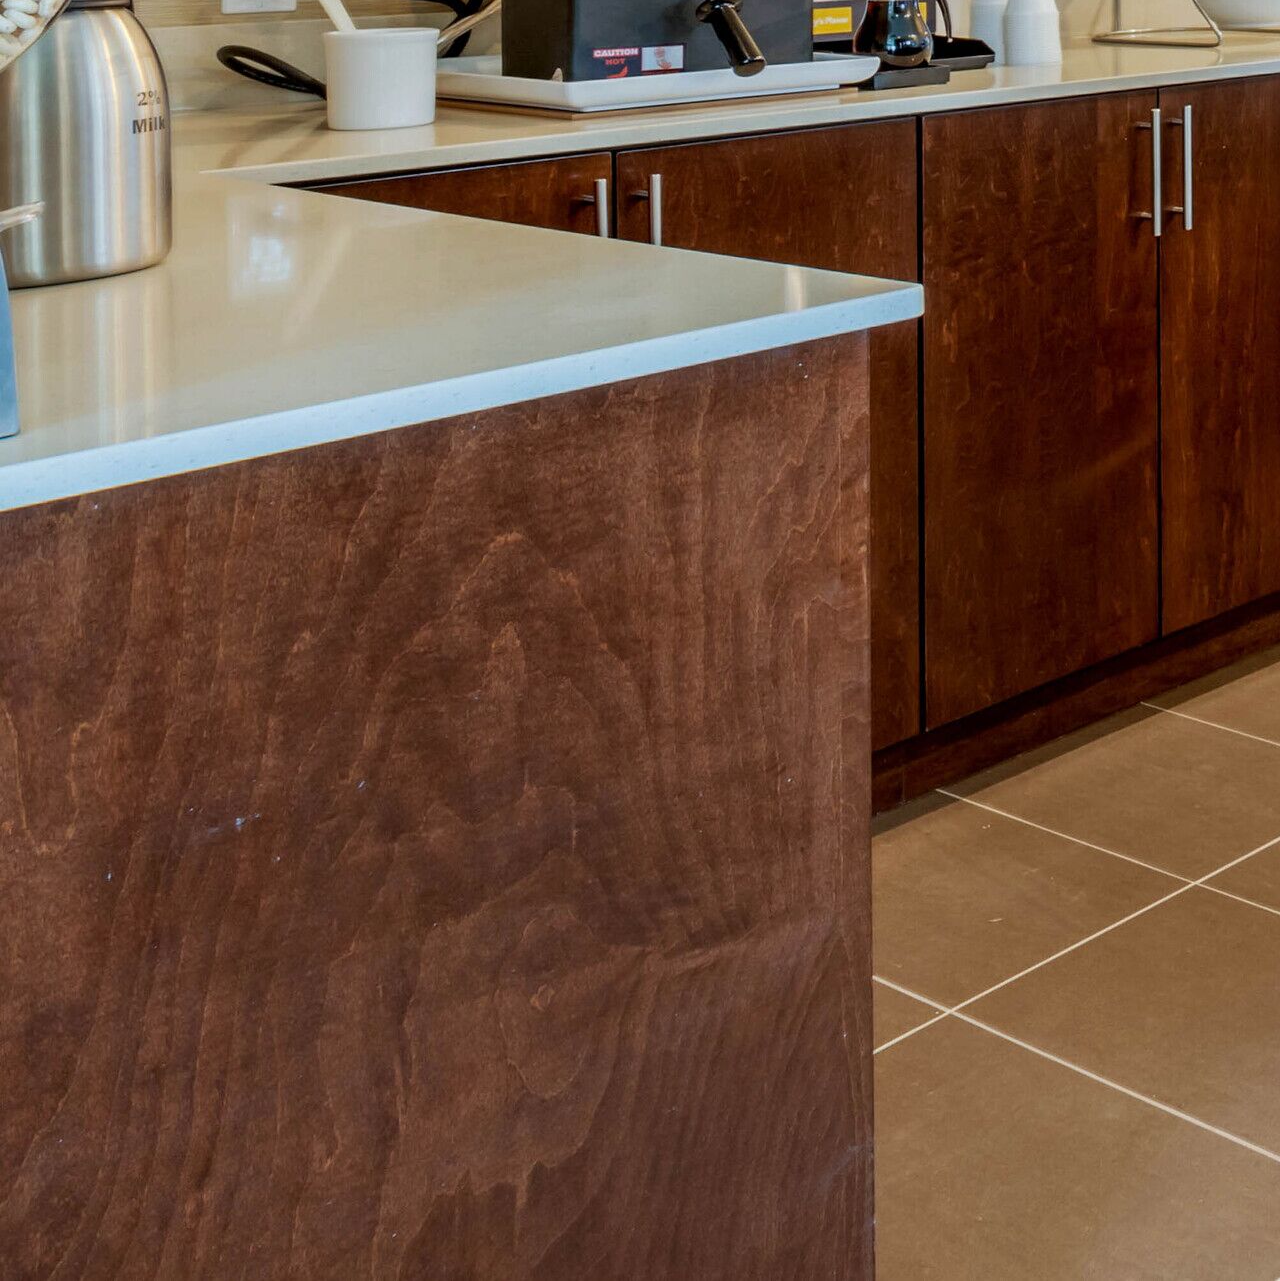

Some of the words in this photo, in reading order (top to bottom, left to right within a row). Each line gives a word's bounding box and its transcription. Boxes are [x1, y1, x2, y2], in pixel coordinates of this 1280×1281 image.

[593, 48, 639, 57] CAUTION
[137, 89, 161, 106] 2%
[132, 115, 166, 134] Milk
